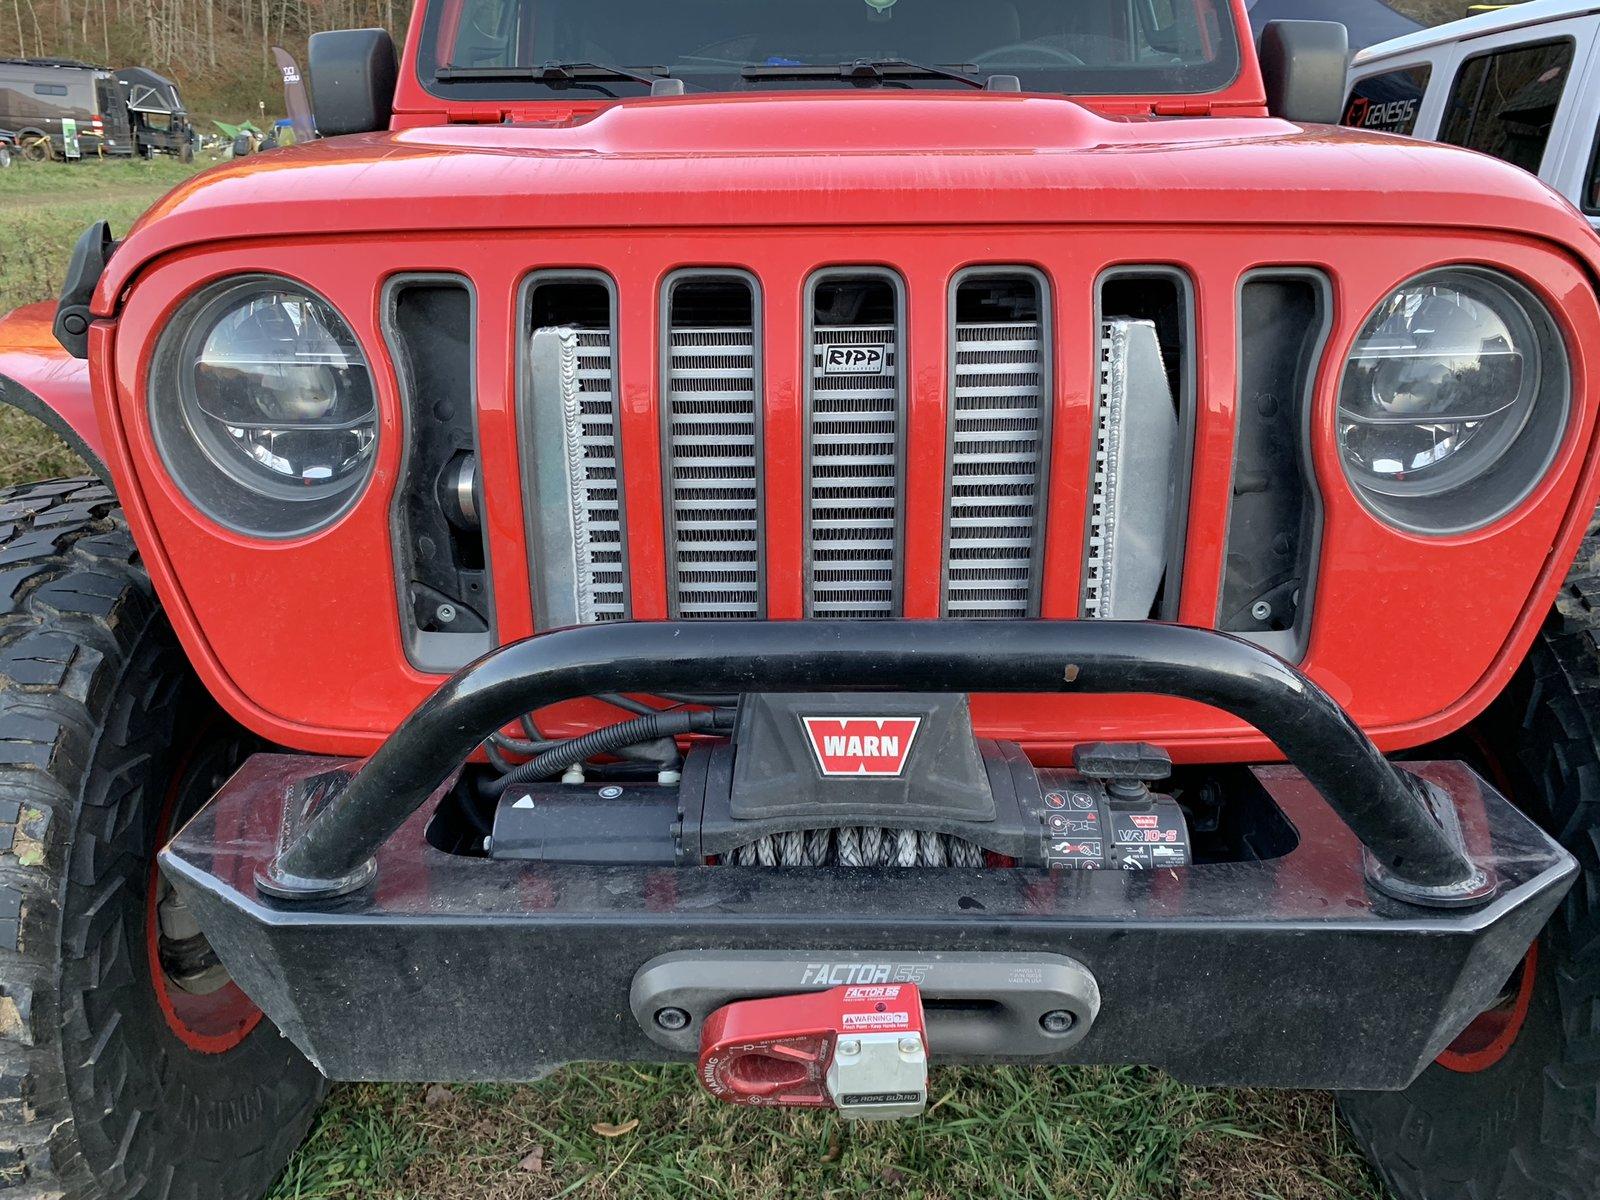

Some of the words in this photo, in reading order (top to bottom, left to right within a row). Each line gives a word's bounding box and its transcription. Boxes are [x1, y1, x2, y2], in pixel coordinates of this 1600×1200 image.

[1365, 99, 1416, 125] GENESIS
[829, 350, 880, 365] RIPP
[824, 736, 898, 756] WARN
[1118, 830, 1177, 841] VR10-S
[800, 964, 891, 984] FACTOR
[893, 964, 928, 984] 55
[844, 987, 885, 998] FACTOR
[855, 1015, 892, 1023] WARNING
[704, 1057, 724, 1094] WARNING
[886, 1094, 917, 1102] GUARD
